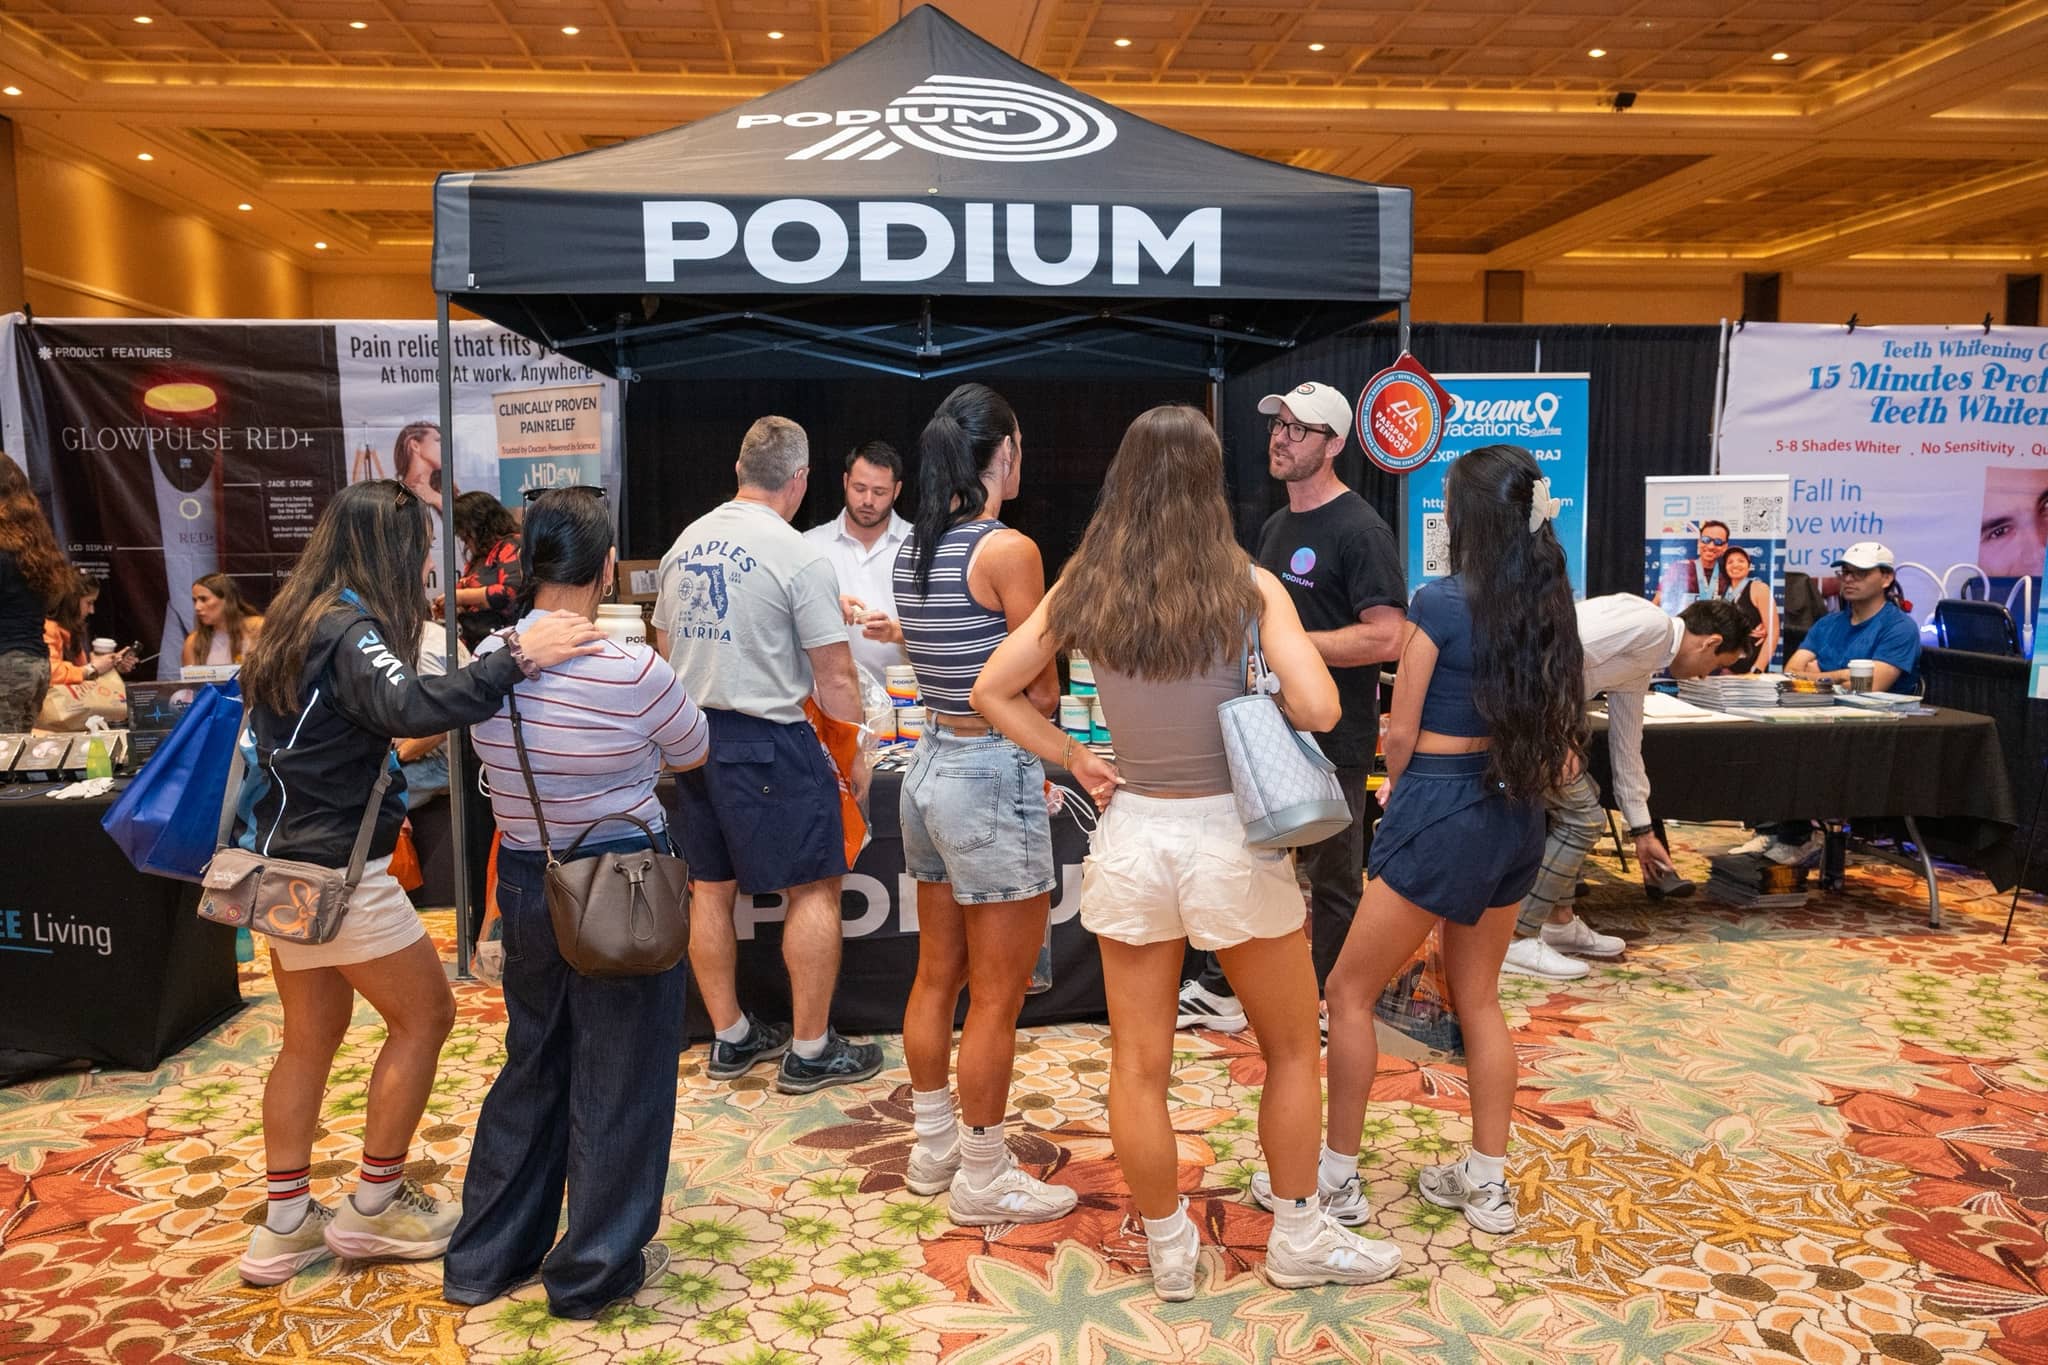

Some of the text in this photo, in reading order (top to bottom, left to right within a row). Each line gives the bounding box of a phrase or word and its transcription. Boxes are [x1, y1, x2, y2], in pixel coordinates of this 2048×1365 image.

[736, 107, 1008, 129] PODIUM
[643, 199, 1222, 287] PODIUM
[55, 347, 172, 358] PRODUCT FEATURES
[350, 334, 392, 358] Pain
[398, 334, 440, 358] relie
[454, 334, 495, 357] that
[500, 333, 531, 356] fits
[1882, 339, 1932, 358] Teeth
[1939, 338, 2034, 363] Whitening
[381, 366, 396, 384] At
[453, 365, 467, 382] At
[473, 364, 516, 382] work.
[521, 362, 593, 384] Anywhere
[1809, 364, 1841, 390] 15
[1849, 361, 1974, 392] Minutes
[499, 397, 597, 416] CLINICALLY PROVEN
[1444, 393, 1538, 422] Dream
[1870, 395, 1948, 424] Teeth
[520, 418, 576, 434] PAIN RELIEF
[1375, 421, 1406, 454] VENDOR
[1376, 411, 1413, 450] PASSPORT
[62, 427, 314, 451] GLOWPULSE RED+
[1776, 440, 1798, 452] 5-8
[1802, 438, 1852, 453] Shades
[1855, 440, 1902, 454] Whiter
[1920, 442, 1940, 455] No
[1944, 440, 2015, 456] Sensitivity
[1535, 449, 1561, 461] RAJ
[266, 480, 312, 488] JADE STONE
[531, 463, 581, 488] HiDow
[1793, 478, 1862, 502] Fall in
[1787, 512, 1884, 534] ove with
[86, 544, 112, 552] DISPLAY
[678, 540, 758, 573] NAPLES
[1788, 548, 1813, 566] ur
[1282, 572, 1314, 588] PODIUM
[33, 912, 112, 956] Living
